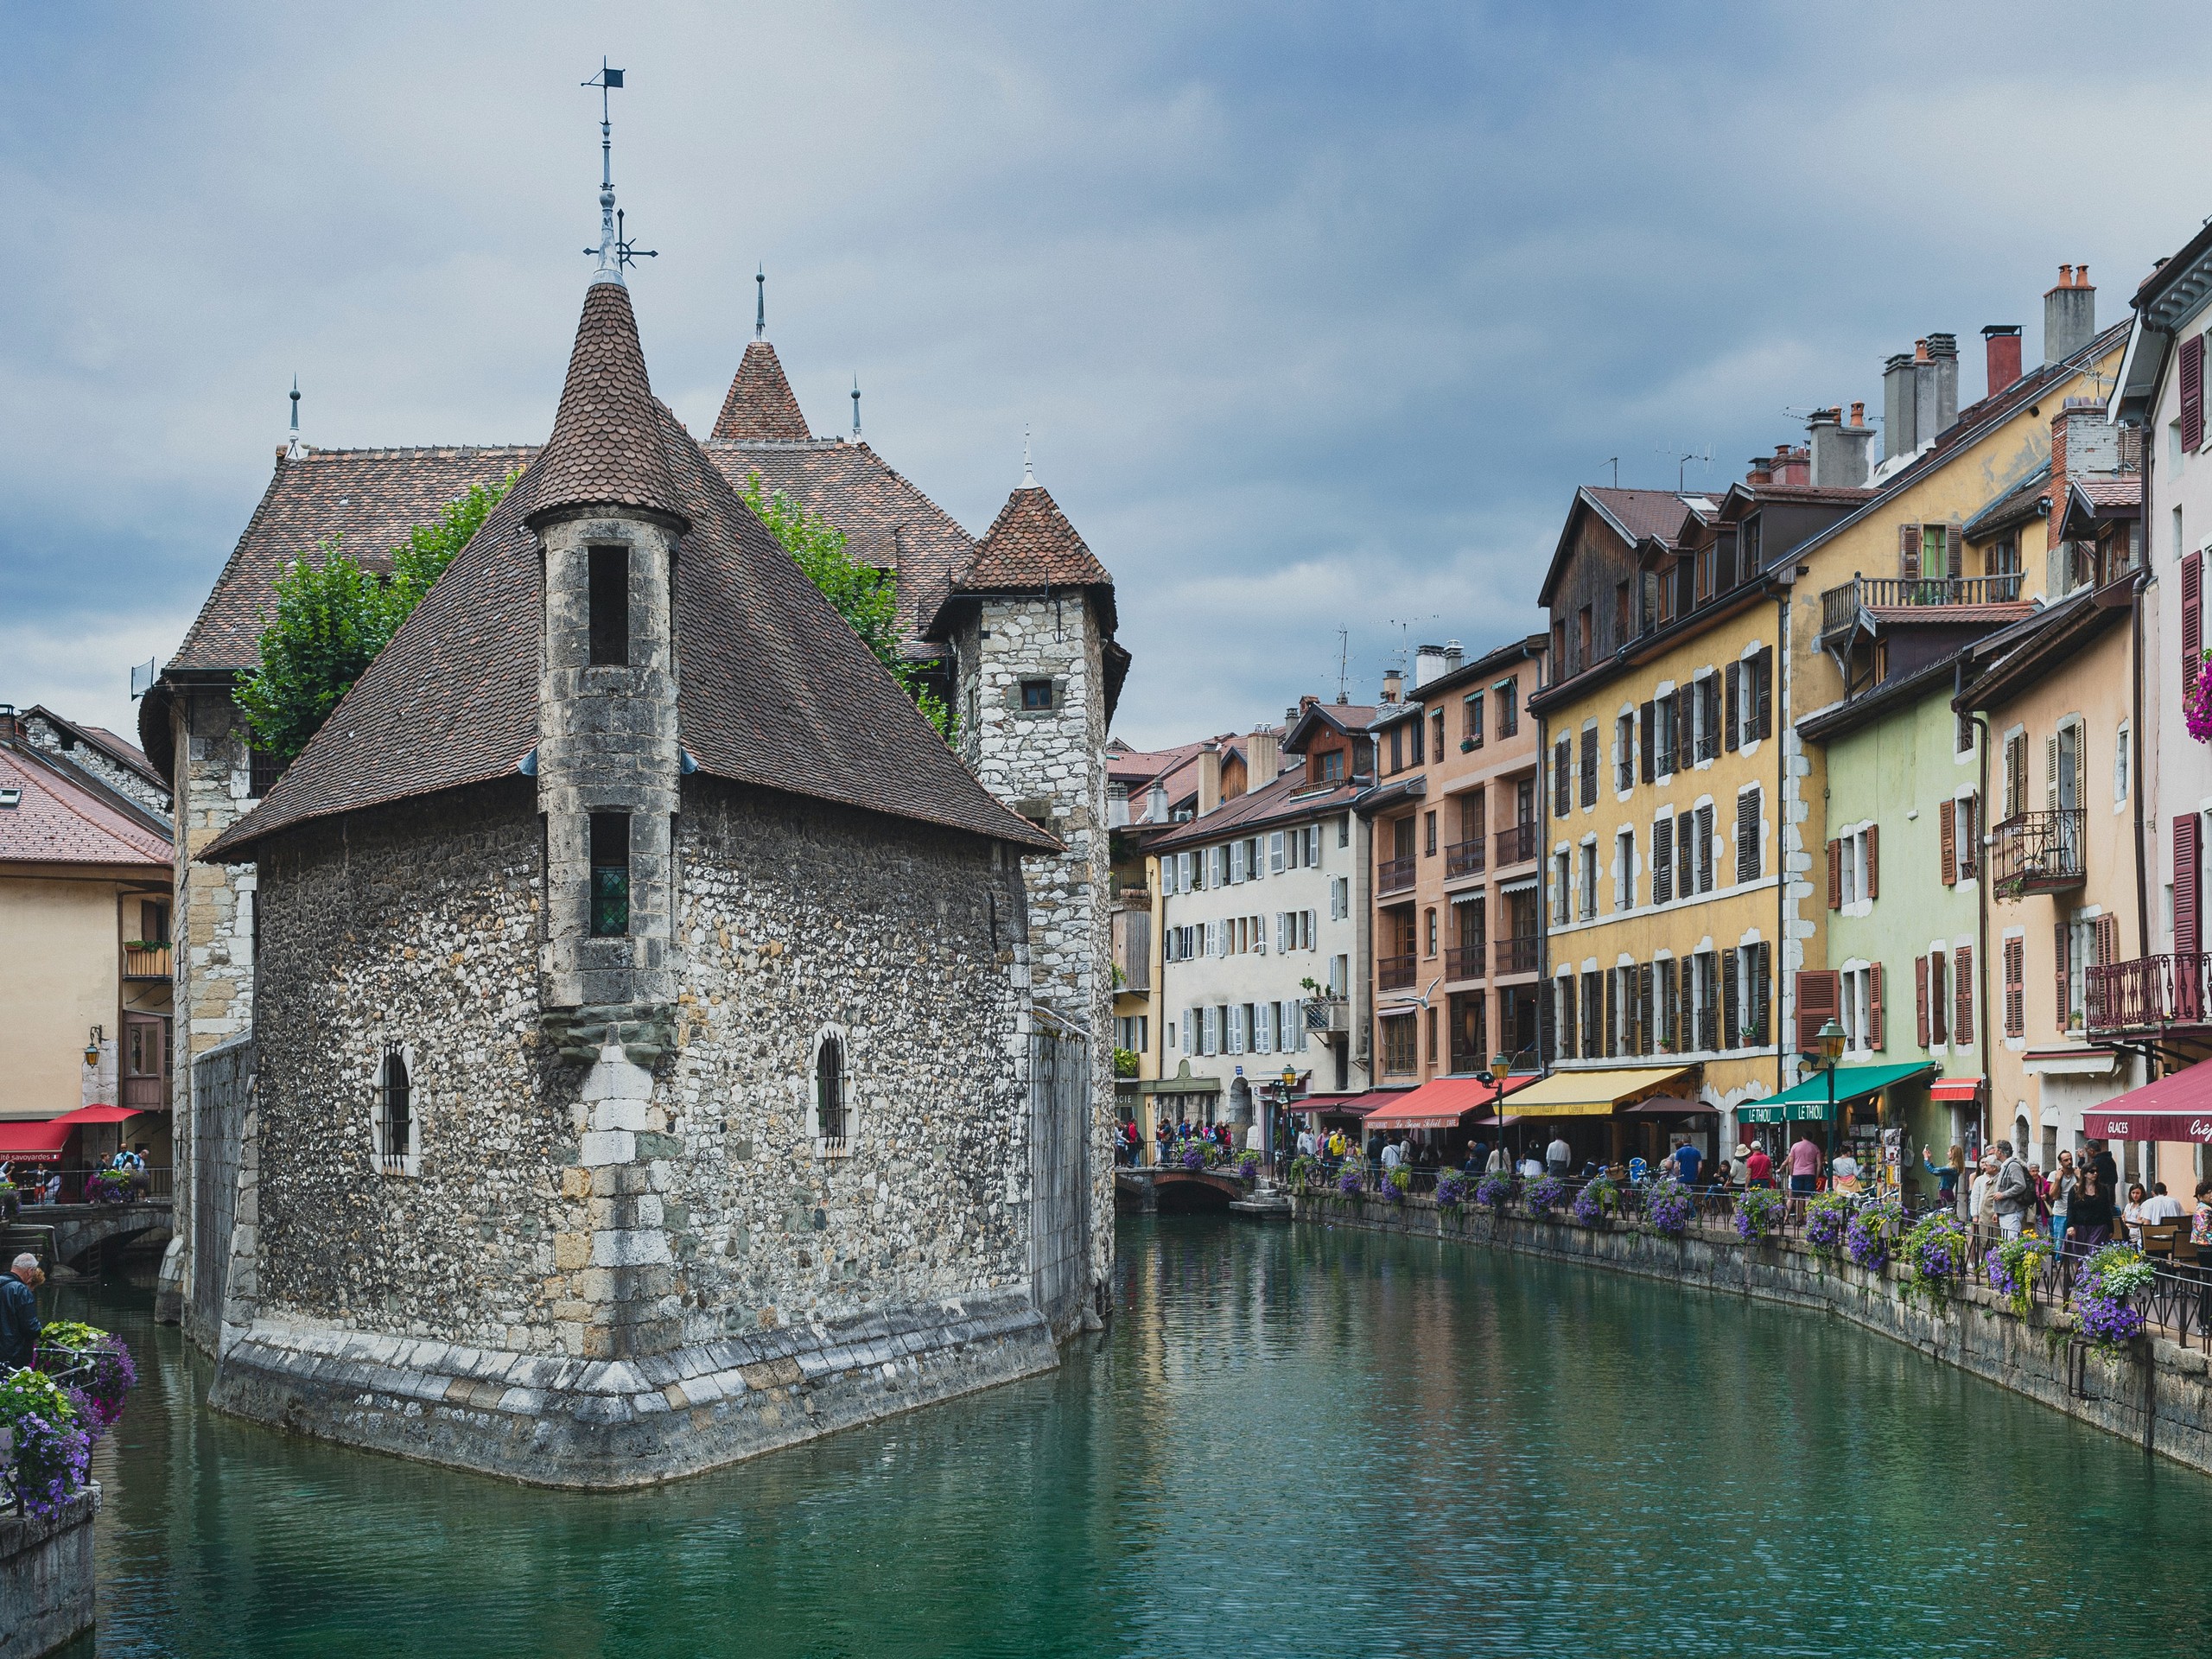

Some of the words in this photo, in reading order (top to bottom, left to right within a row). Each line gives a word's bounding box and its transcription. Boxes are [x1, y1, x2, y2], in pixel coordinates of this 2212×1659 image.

[1749, 1109, 1755, 1122] LE
[1756, 1109, 1771, 1122] THIOU
[1798, 1106, 1805, 1120] LE
[1806, 1105, 1823, 1120] THIOU
[2108, 1122, 2128, 1134] GLACES
